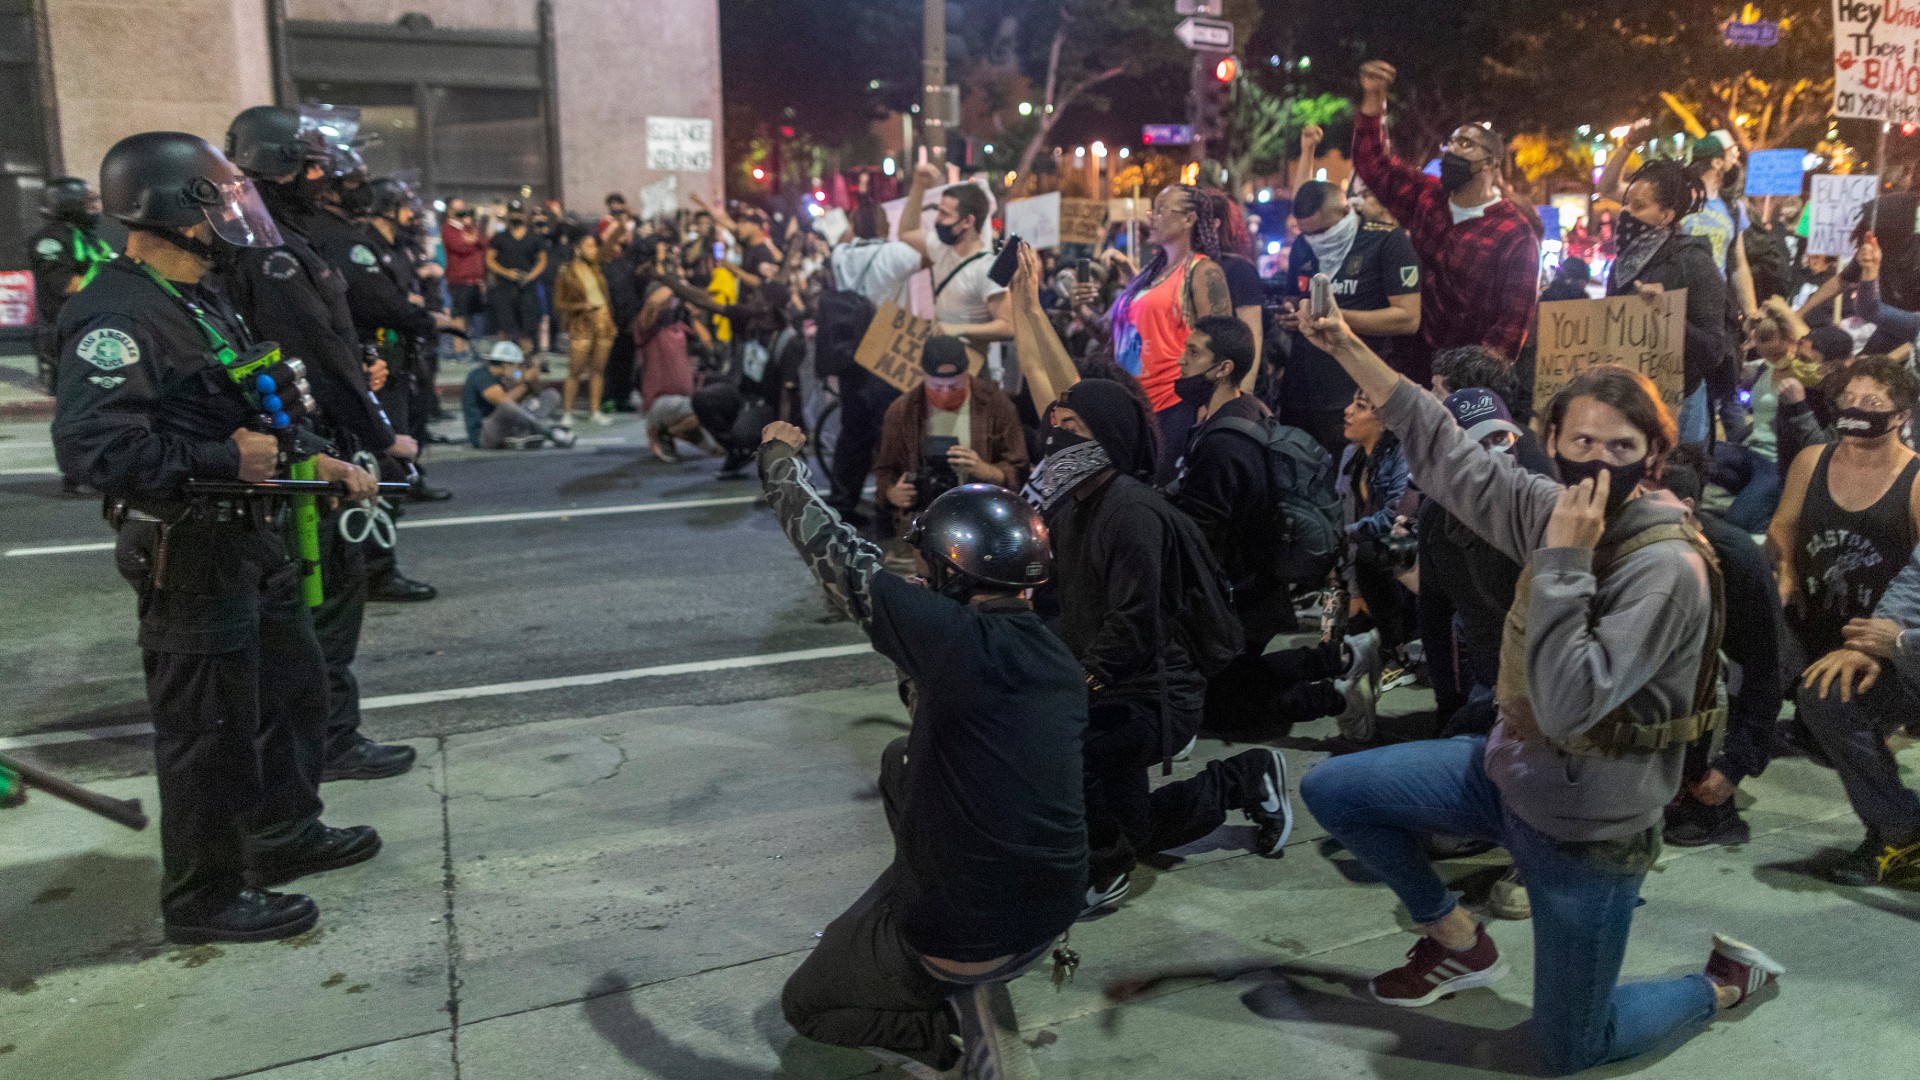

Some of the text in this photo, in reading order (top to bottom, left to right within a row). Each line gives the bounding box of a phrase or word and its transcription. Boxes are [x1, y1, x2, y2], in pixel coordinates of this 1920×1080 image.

[1838, 0, 1881, 34] Hey
[1848, 33, 1905, 60] There
[1860, 58, 1920, 93] BLOO
[1817, 178, 1876, 204] BLACK
[1811, 227, 1850, 253] MAT
[893, 309, 932, 340] BLA
[80, 330, 137, 358] LOS ANGELES
[891, 333, 921, 362] LI
[91, 354, 123, 367] POLICE
[874, 353, 926, 388] MAT
